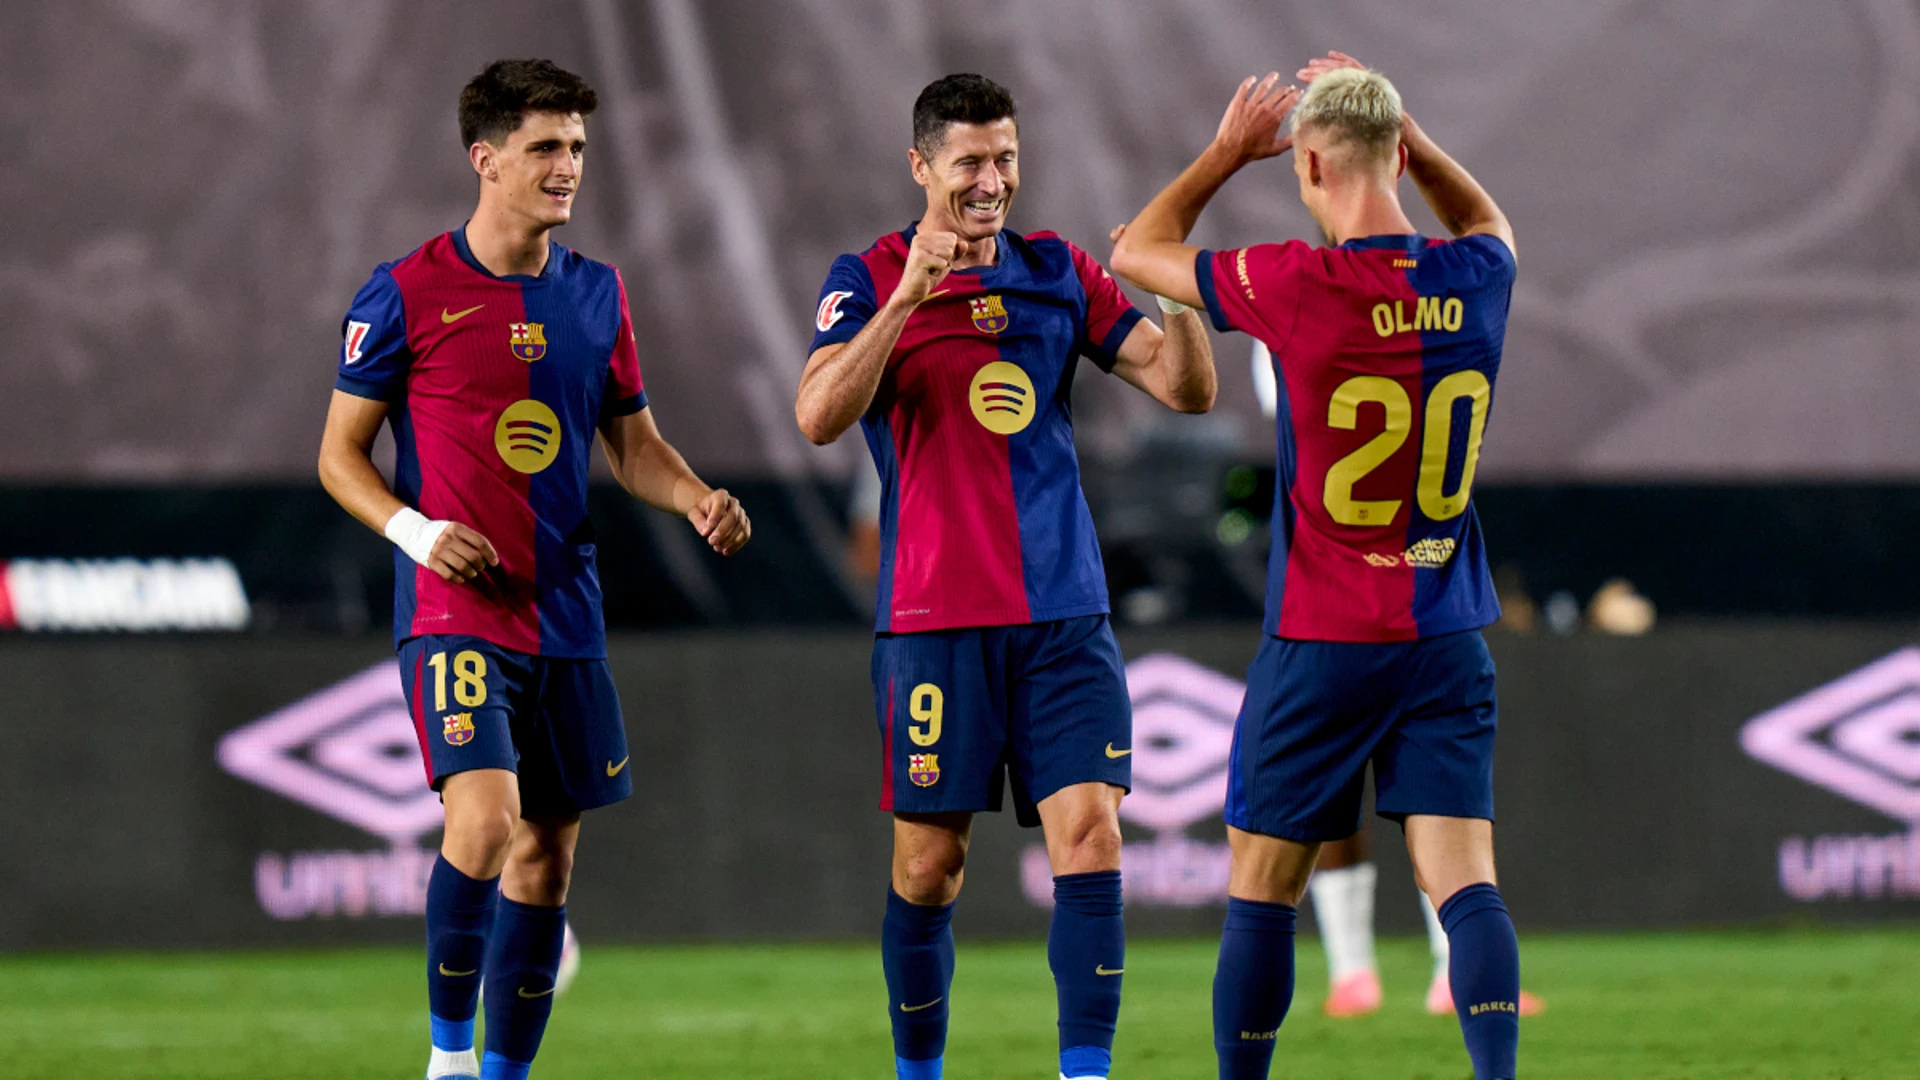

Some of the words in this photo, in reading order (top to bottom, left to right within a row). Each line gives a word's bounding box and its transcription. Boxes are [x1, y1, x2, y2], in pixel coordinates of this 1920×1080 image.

[1372, 296, 1463, 338] OLMO
[1323, 369, 1490, 525] 20
[427, 650, 487, 712] 18
[908, 682, 943, 746] 9
